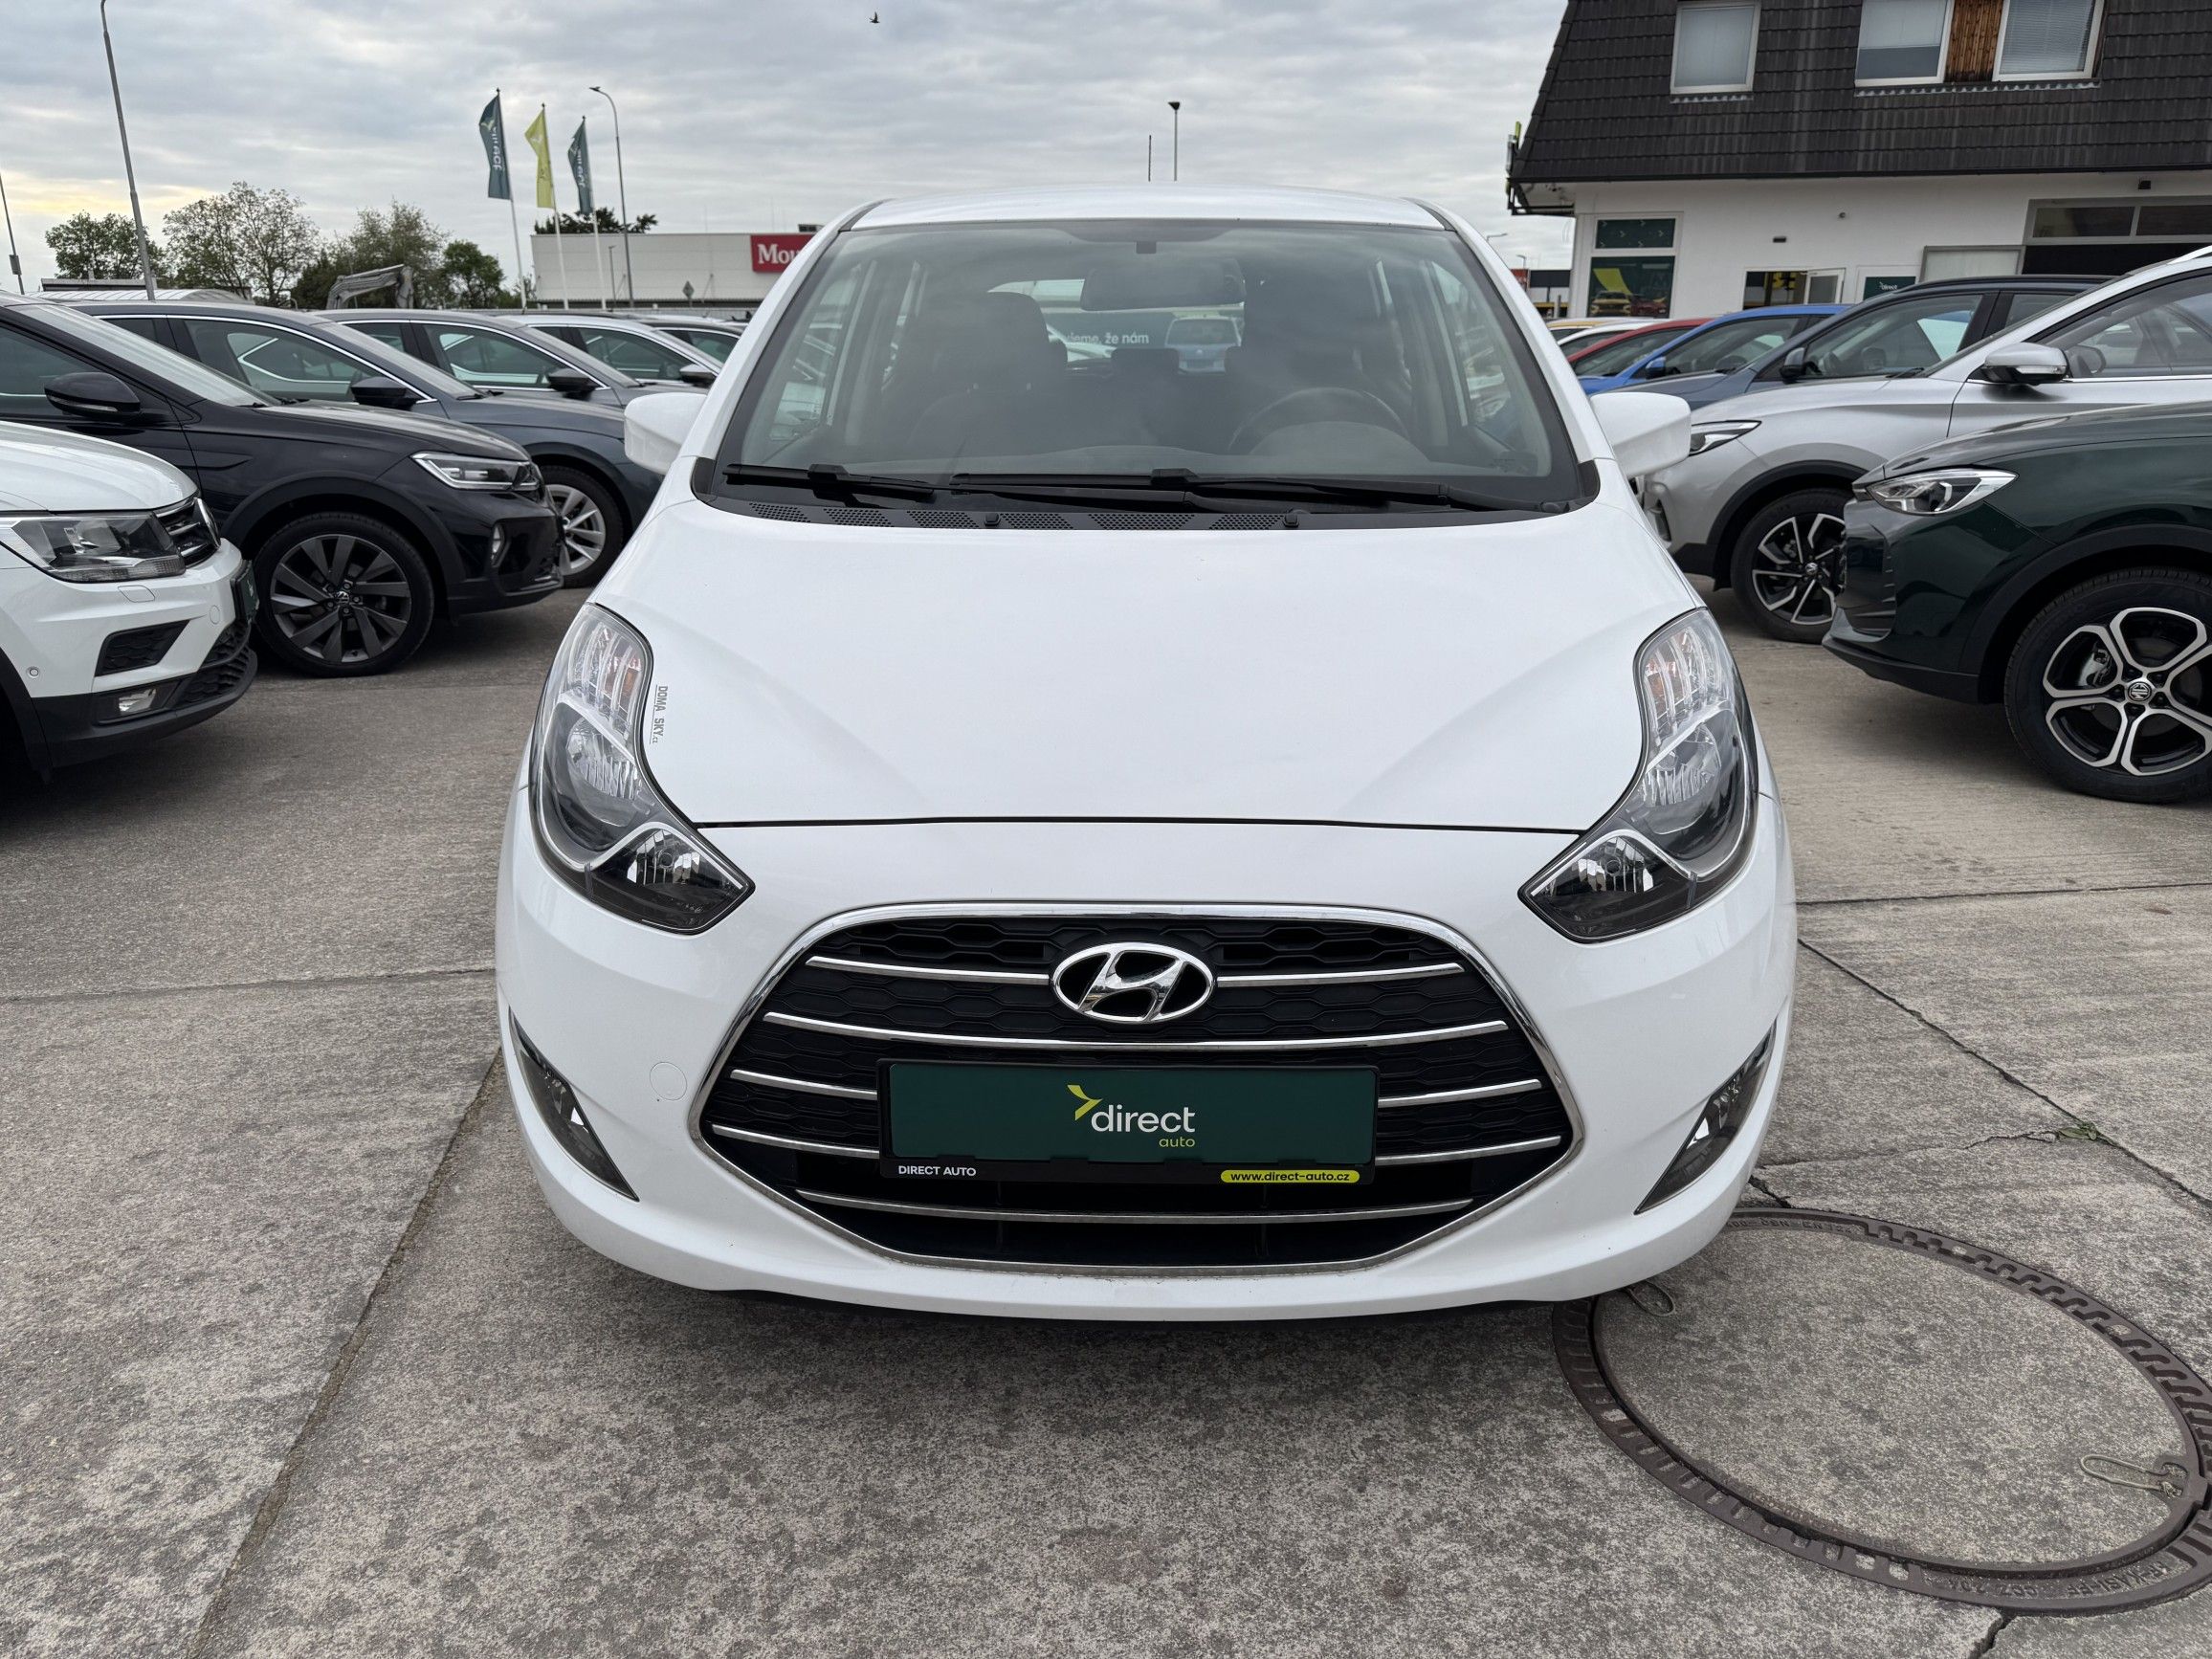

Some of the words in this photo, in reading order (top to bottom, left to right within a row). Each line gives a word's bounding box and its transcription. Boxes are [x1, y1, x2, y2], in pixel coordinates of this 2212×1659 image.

[1121, 331, 1150, 344] nám
[1091, 1103, 1196, 1133] direct
[1159, 1136, 1196, 1148] auto
[898, 1165, 940, 1176] DIRECT
[943, 1166, 977, 1177] AUTO
[1230, 1171, 1350, 1182] www.direct-auto.cz
